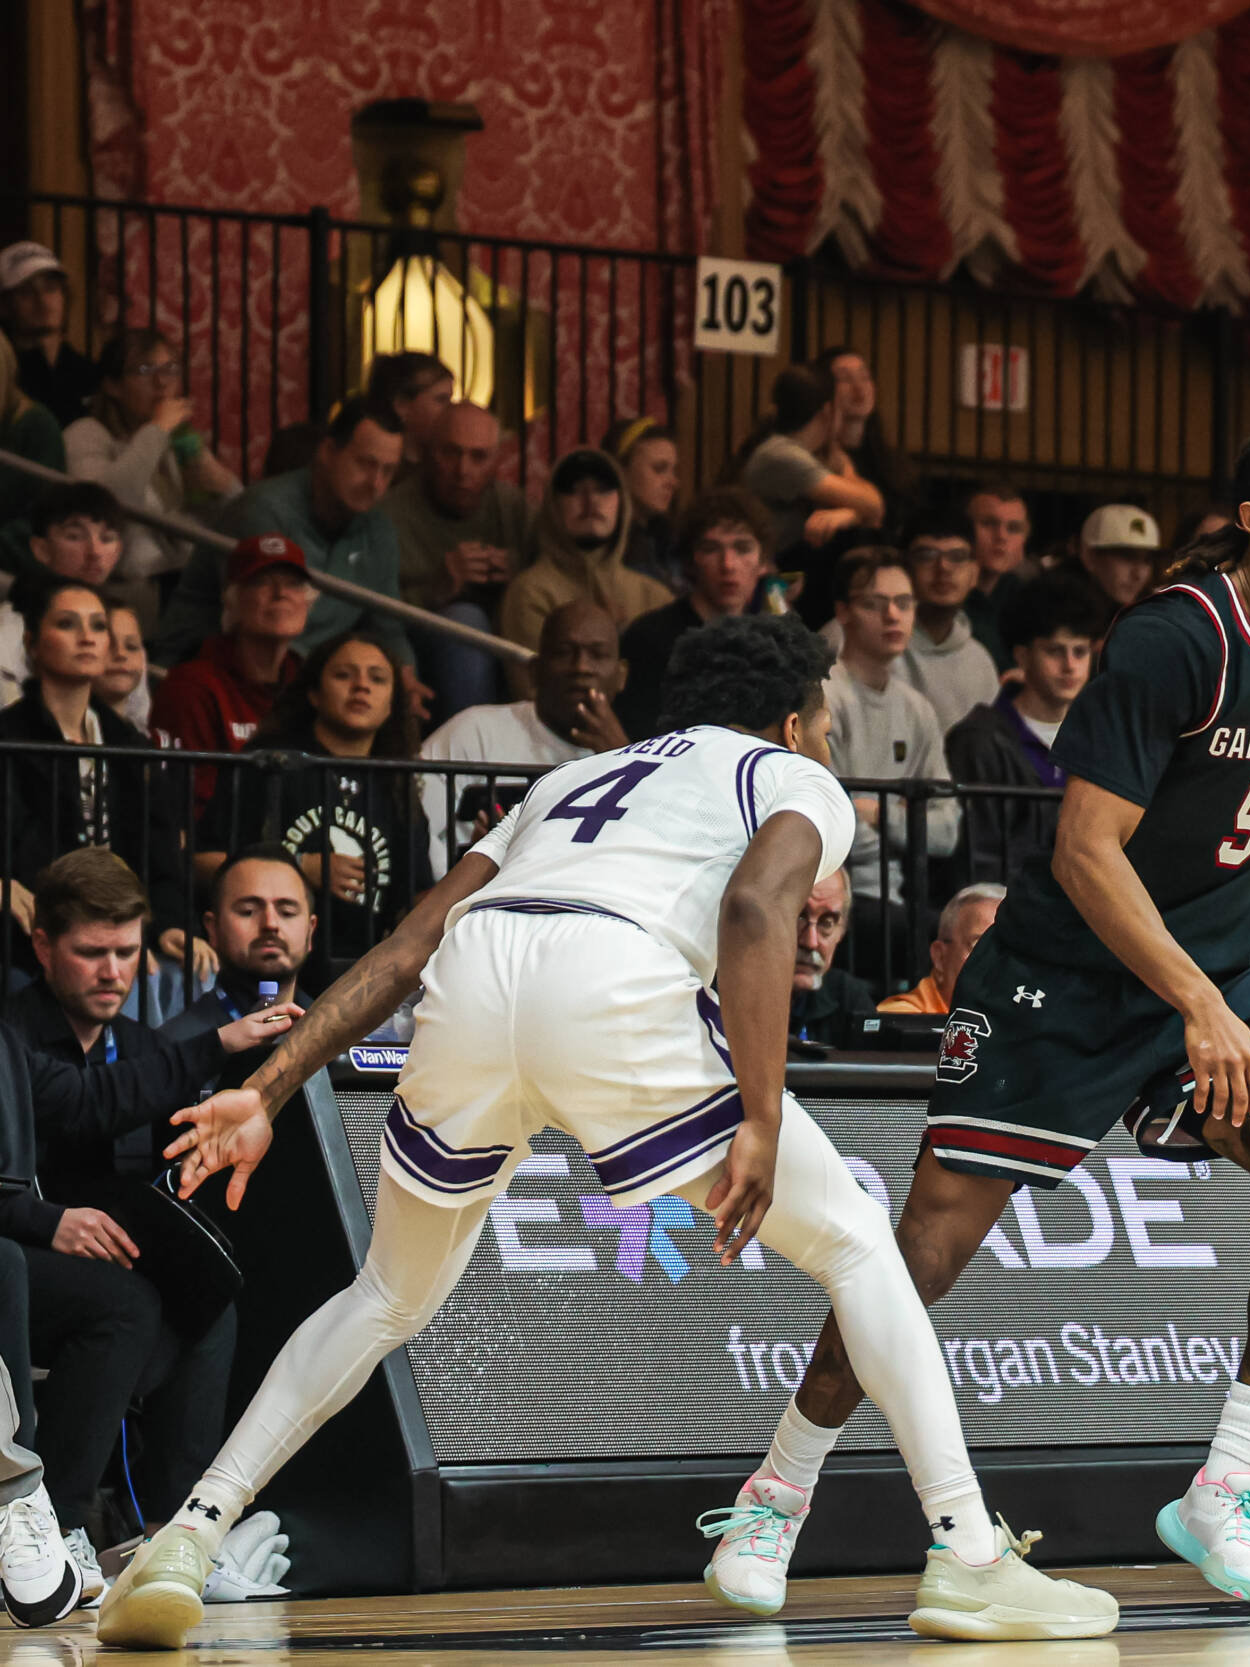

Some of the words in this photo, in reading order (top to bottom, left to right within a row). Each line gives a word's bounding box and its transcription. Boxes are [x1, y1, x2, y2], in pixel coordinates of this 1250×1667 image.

[702, 272, 775, 336] 103
[542, 760, 663, 843] 4
[725, 1325, 816, 1390] fro
[941, 1338, 1060, 1404] rgan
